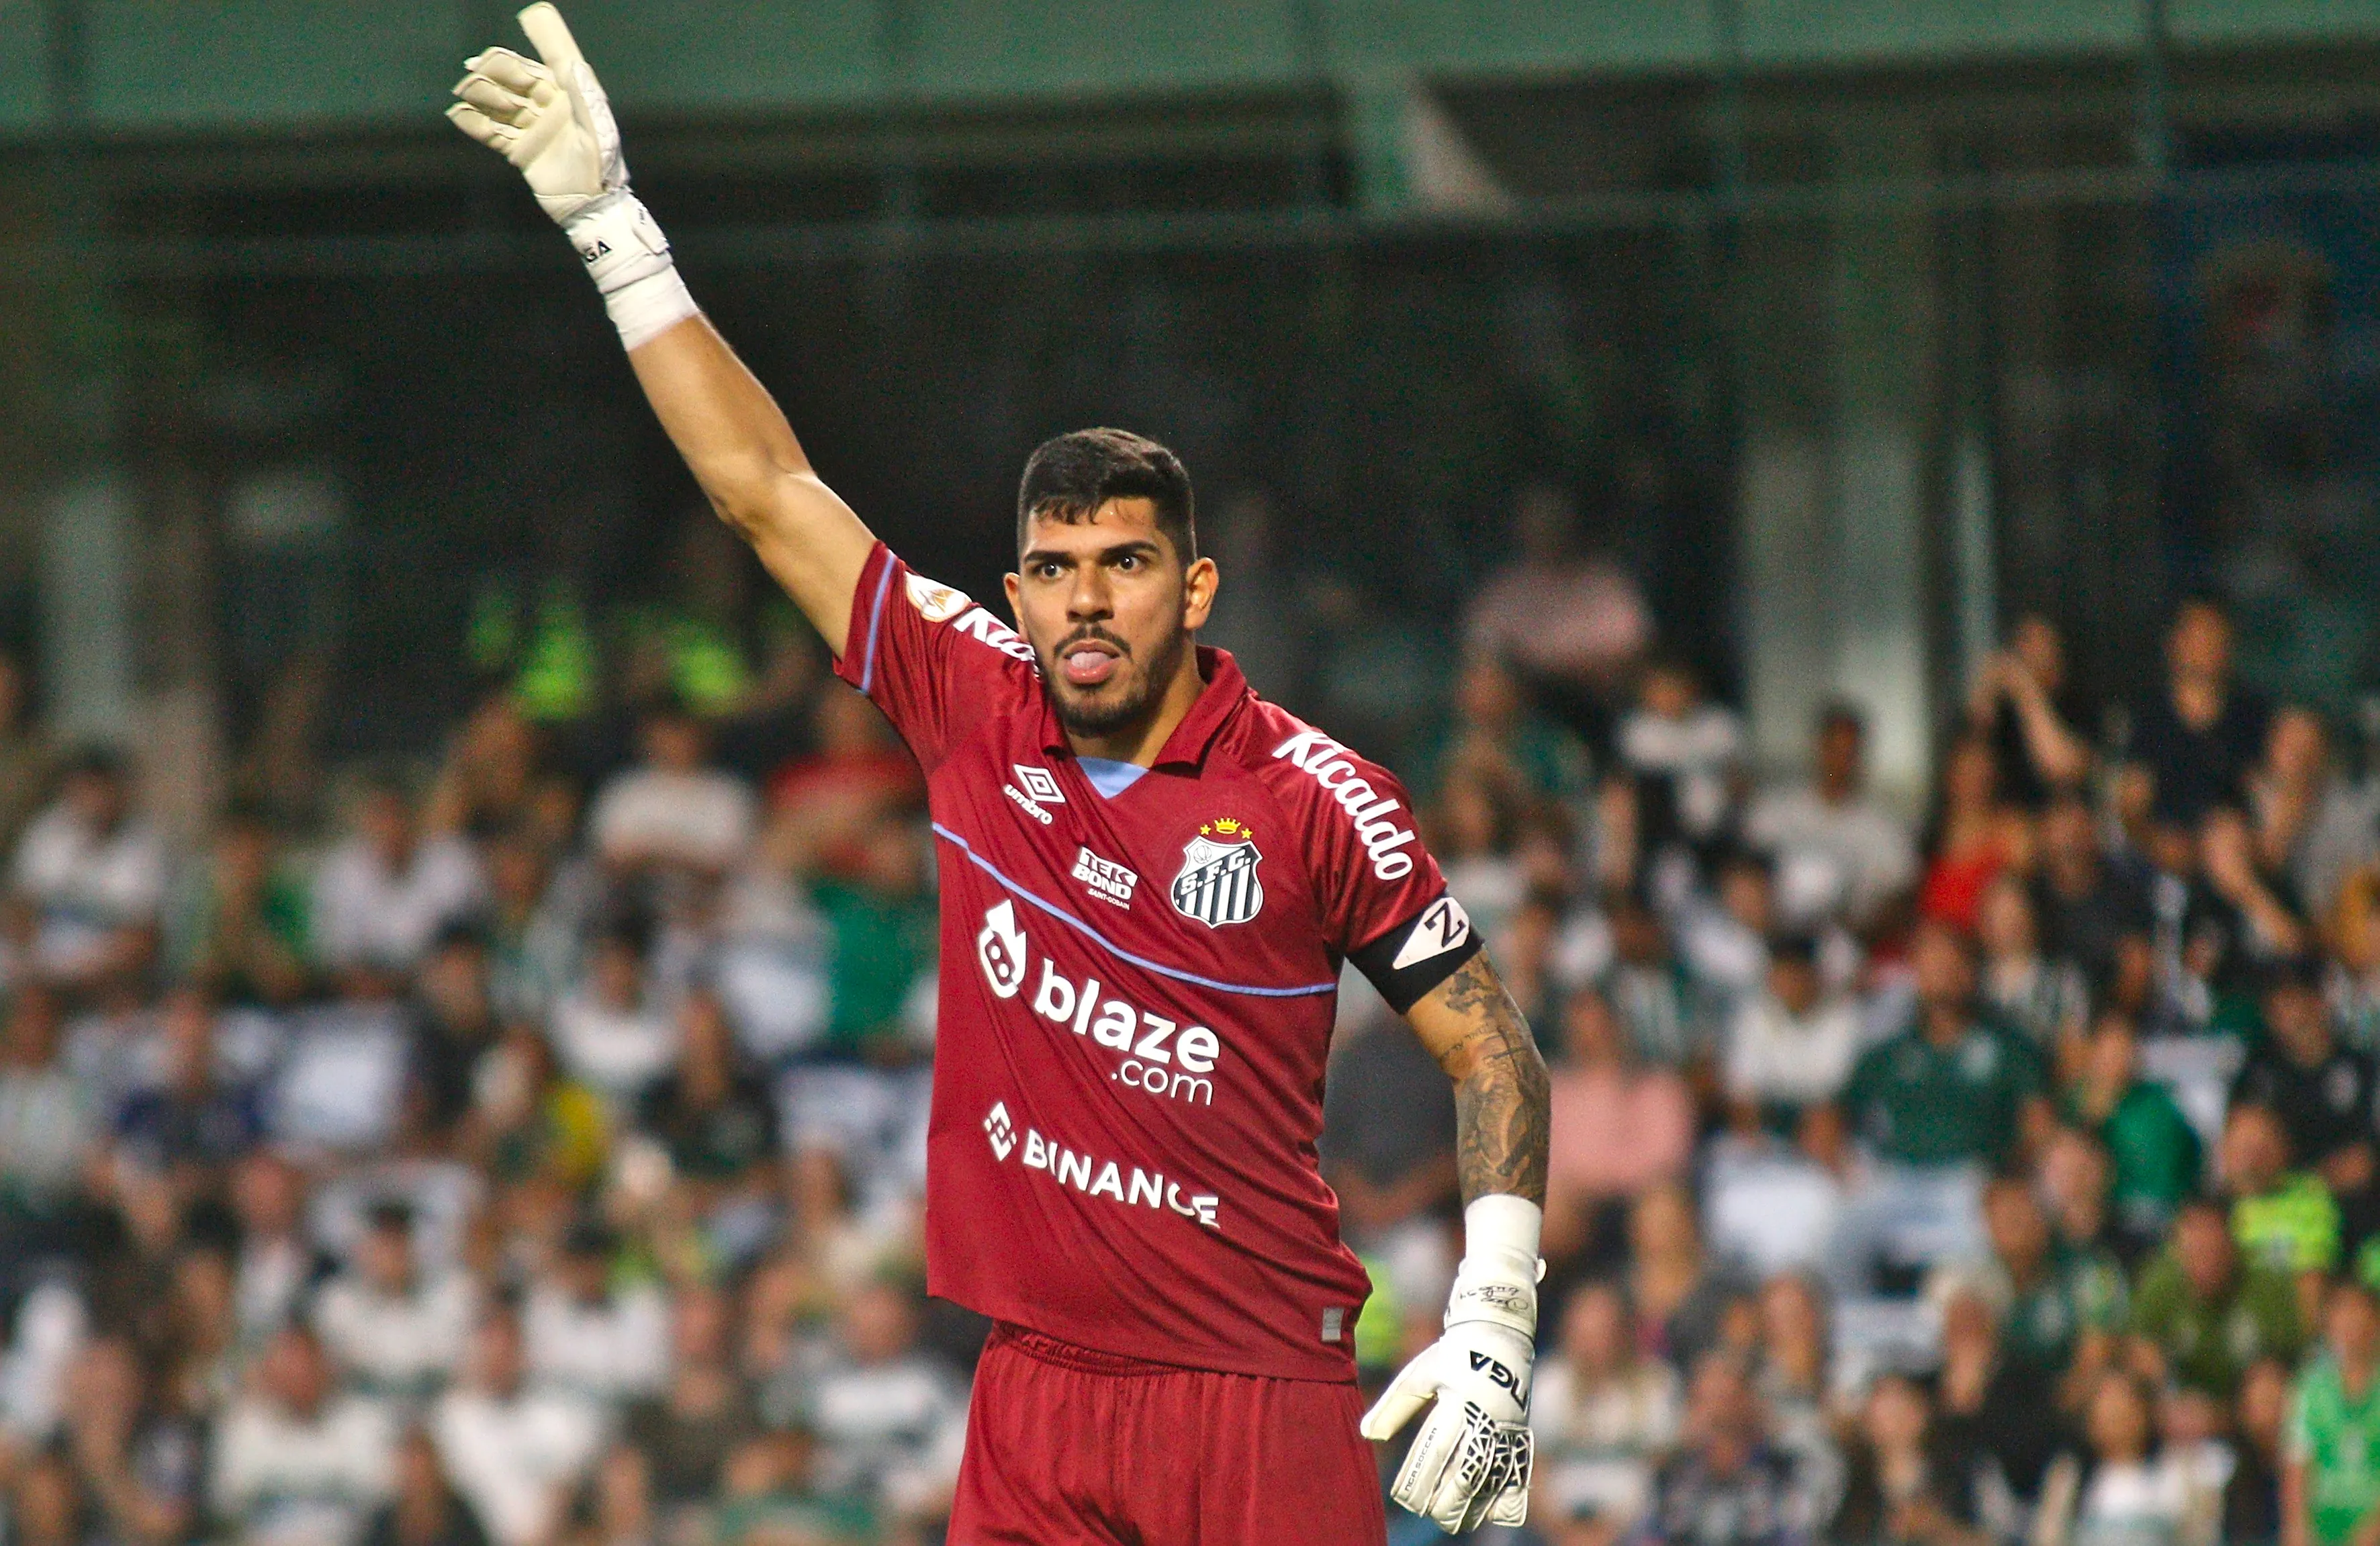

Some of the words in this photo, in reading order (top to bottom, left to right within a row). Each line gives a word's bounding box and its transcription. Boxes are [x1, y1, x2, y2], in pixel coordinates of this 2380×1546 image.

[1004, 784, 1053, 825] umbro
[1272, 730, 1416, 881] Kicaldo
[1071, 864, 1133, 900] BOND
[1088, 888, 1130, 910] SAINT-GOBAIN
[1034, 958, 1220, 1073] blaze
[1111, 1060, 1214, 1106] .com
[1023, 1128, 1221, 1229] BINANCE
